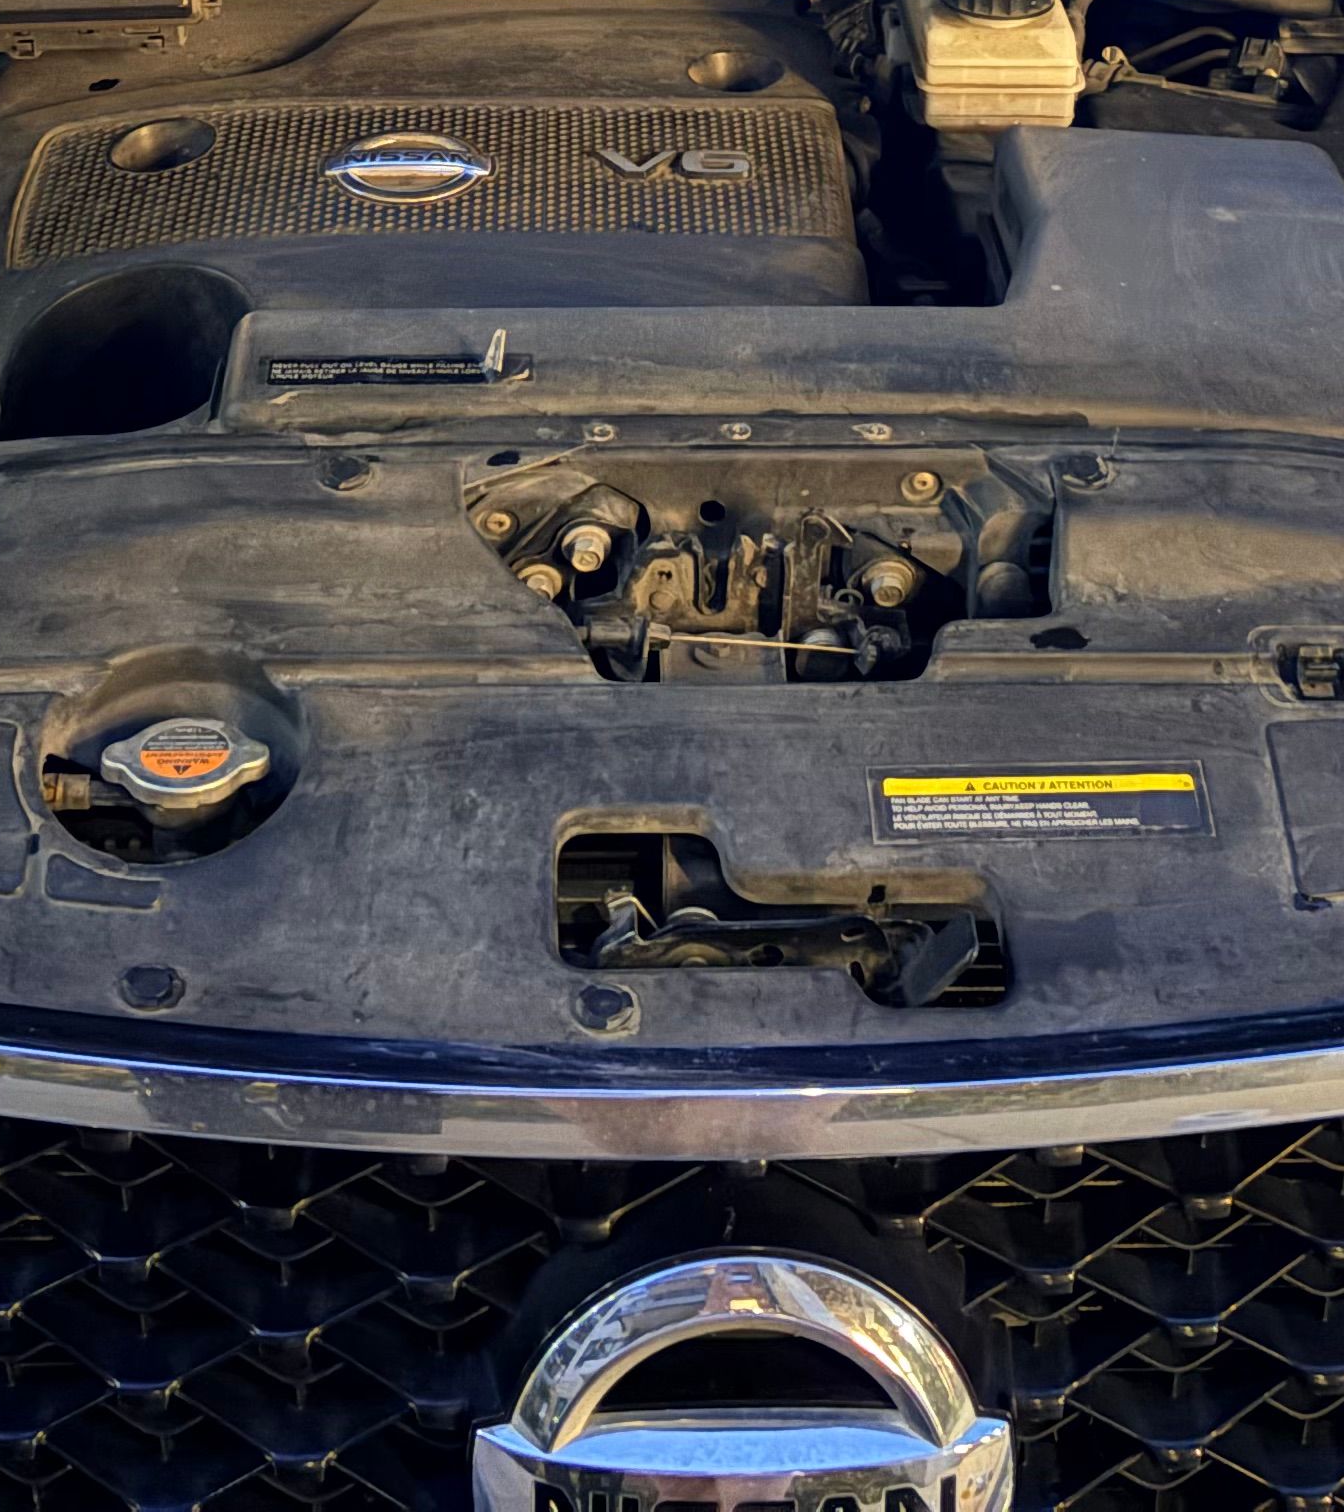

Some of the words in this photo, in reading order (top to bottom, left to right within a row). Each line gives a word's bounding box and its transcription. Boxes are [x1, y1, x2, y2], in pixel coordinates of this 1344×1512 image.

[344, 150, 473, 165] NISSAN
[596, 149, 753, 180] V6
[983, 781, 1036, 791] CAUTION
[1048, 779, 1113, 790] ATTENTION
